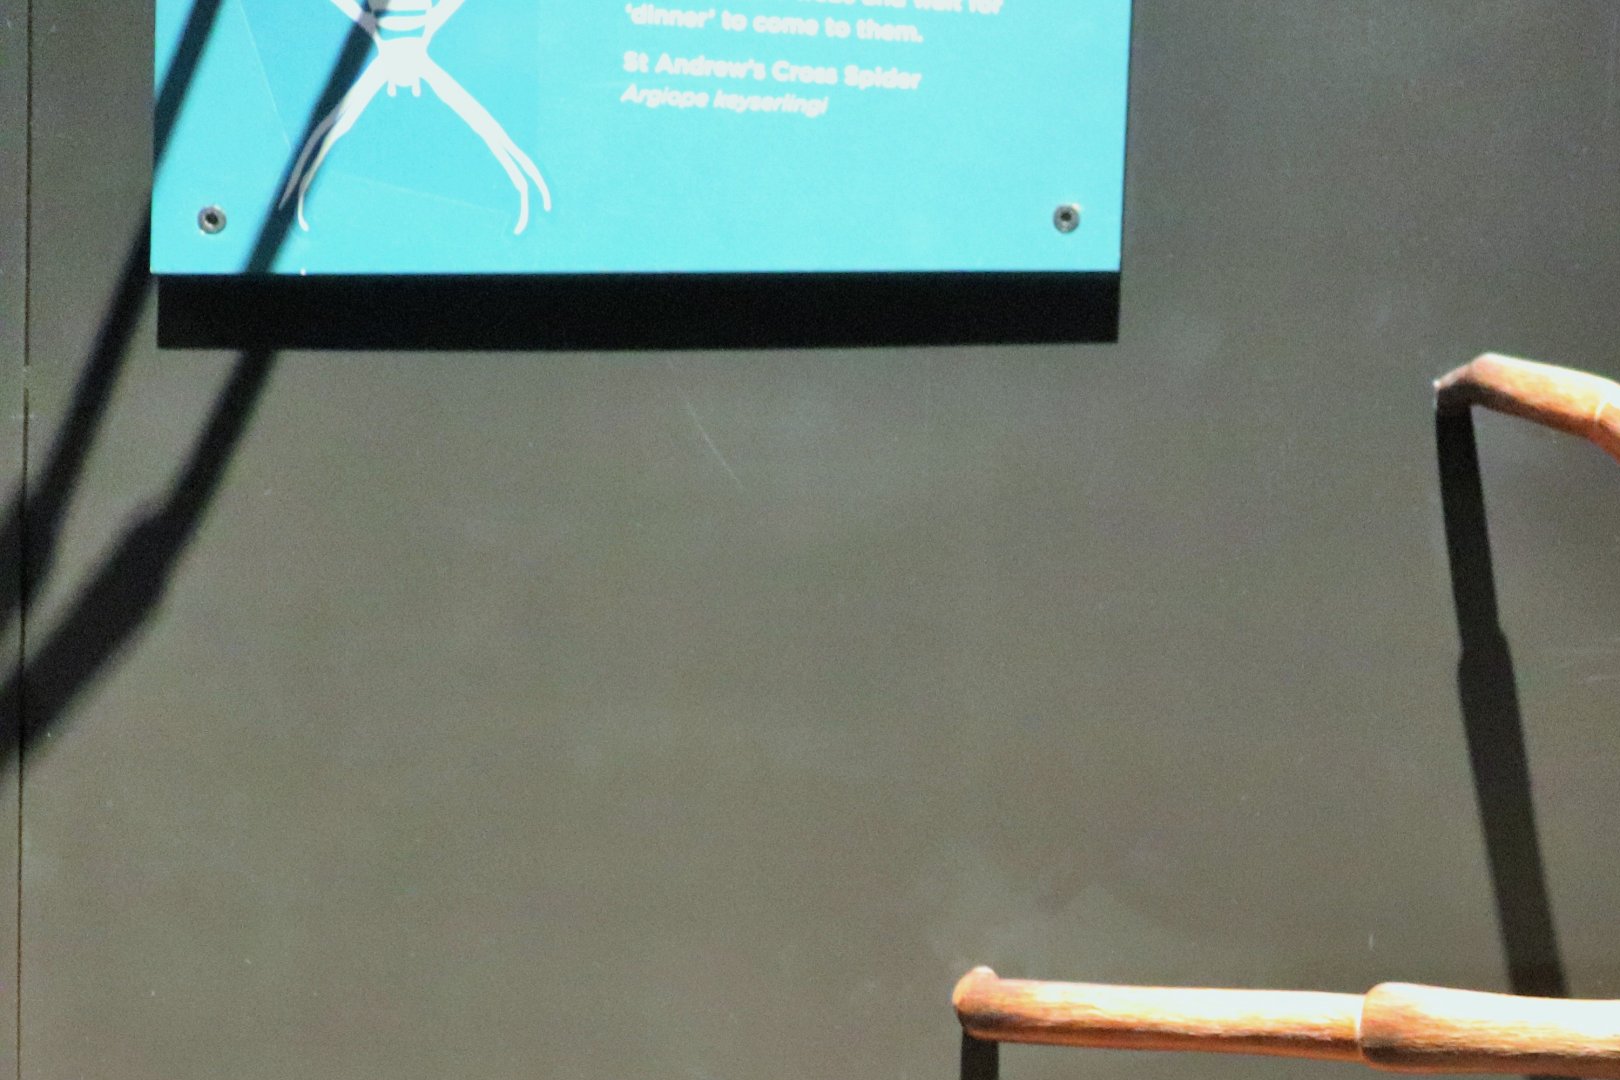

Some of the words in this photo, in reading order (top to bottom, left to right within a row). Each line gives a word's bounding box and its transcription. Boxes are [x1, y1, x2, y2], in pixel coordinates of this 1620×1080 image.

[721, 10, 747, 31] to
[753, 15, 819, 36] come
[825, 17, 850, 38] to
[856, 18, 924, 43] them.
[623, 51, 649, 72] St
[771, 60, 838, 84] Cross
[844, 65, 922, 90] Spider
[620, 83, 709, 108] Argiope
[713, 89, 828, 118] keyserlingi
